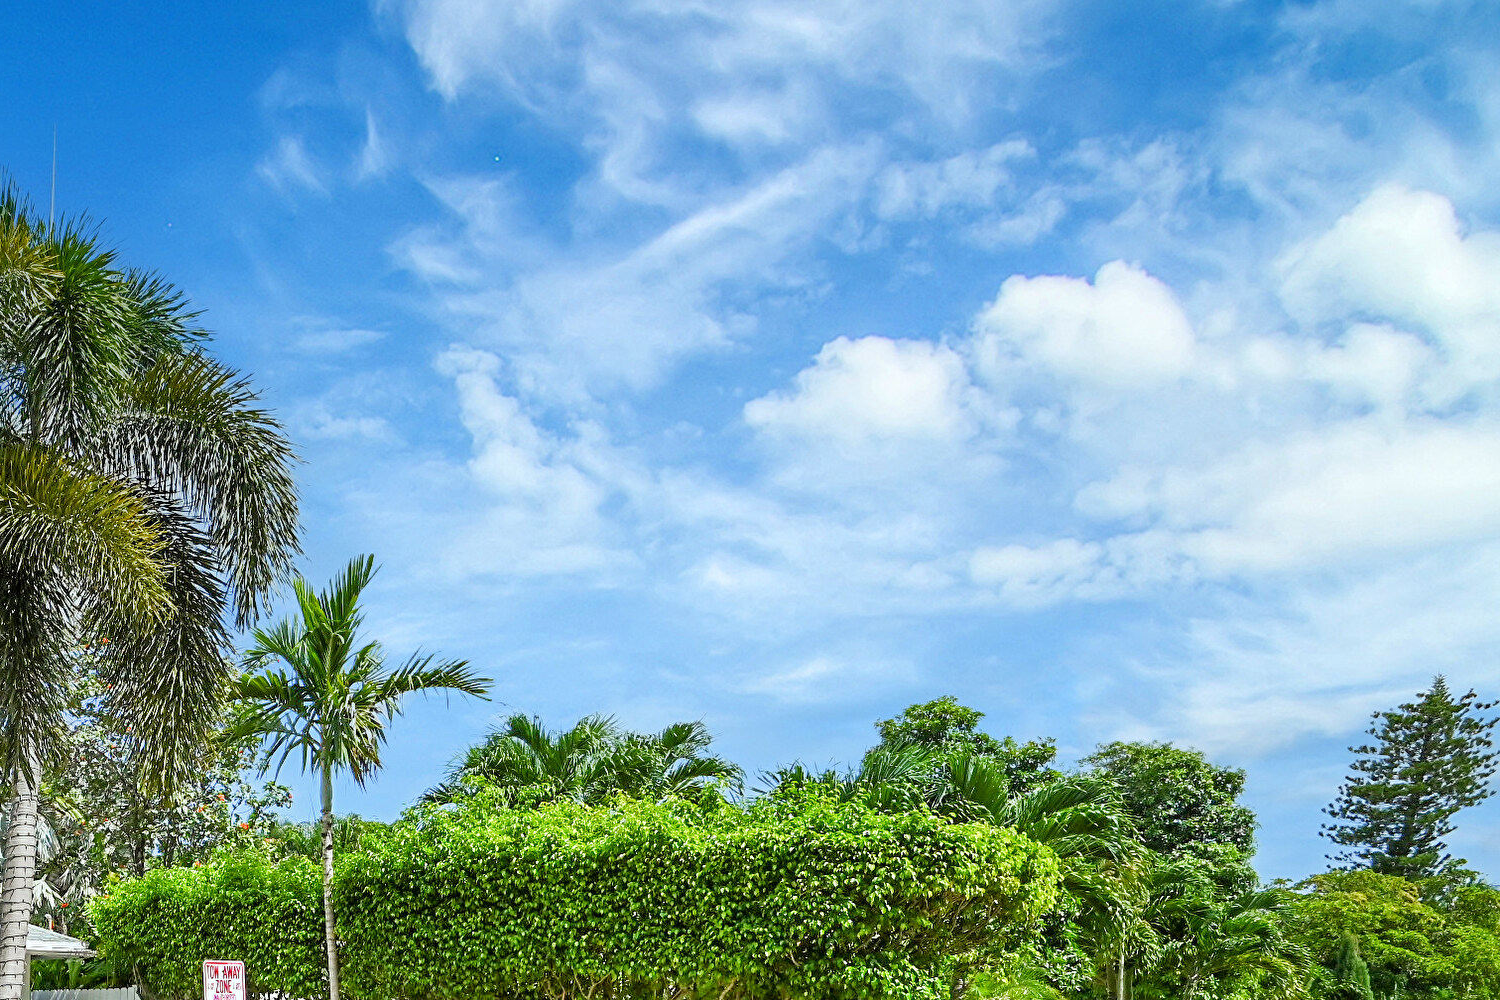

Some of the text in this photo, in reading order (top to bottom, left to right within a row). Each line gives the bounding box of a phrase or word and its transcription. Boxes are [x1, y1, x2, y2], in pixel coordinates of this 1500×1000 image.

[206, 965, 240, 979] TOW AWAY
[216, 980, 232, 993] ZONE
